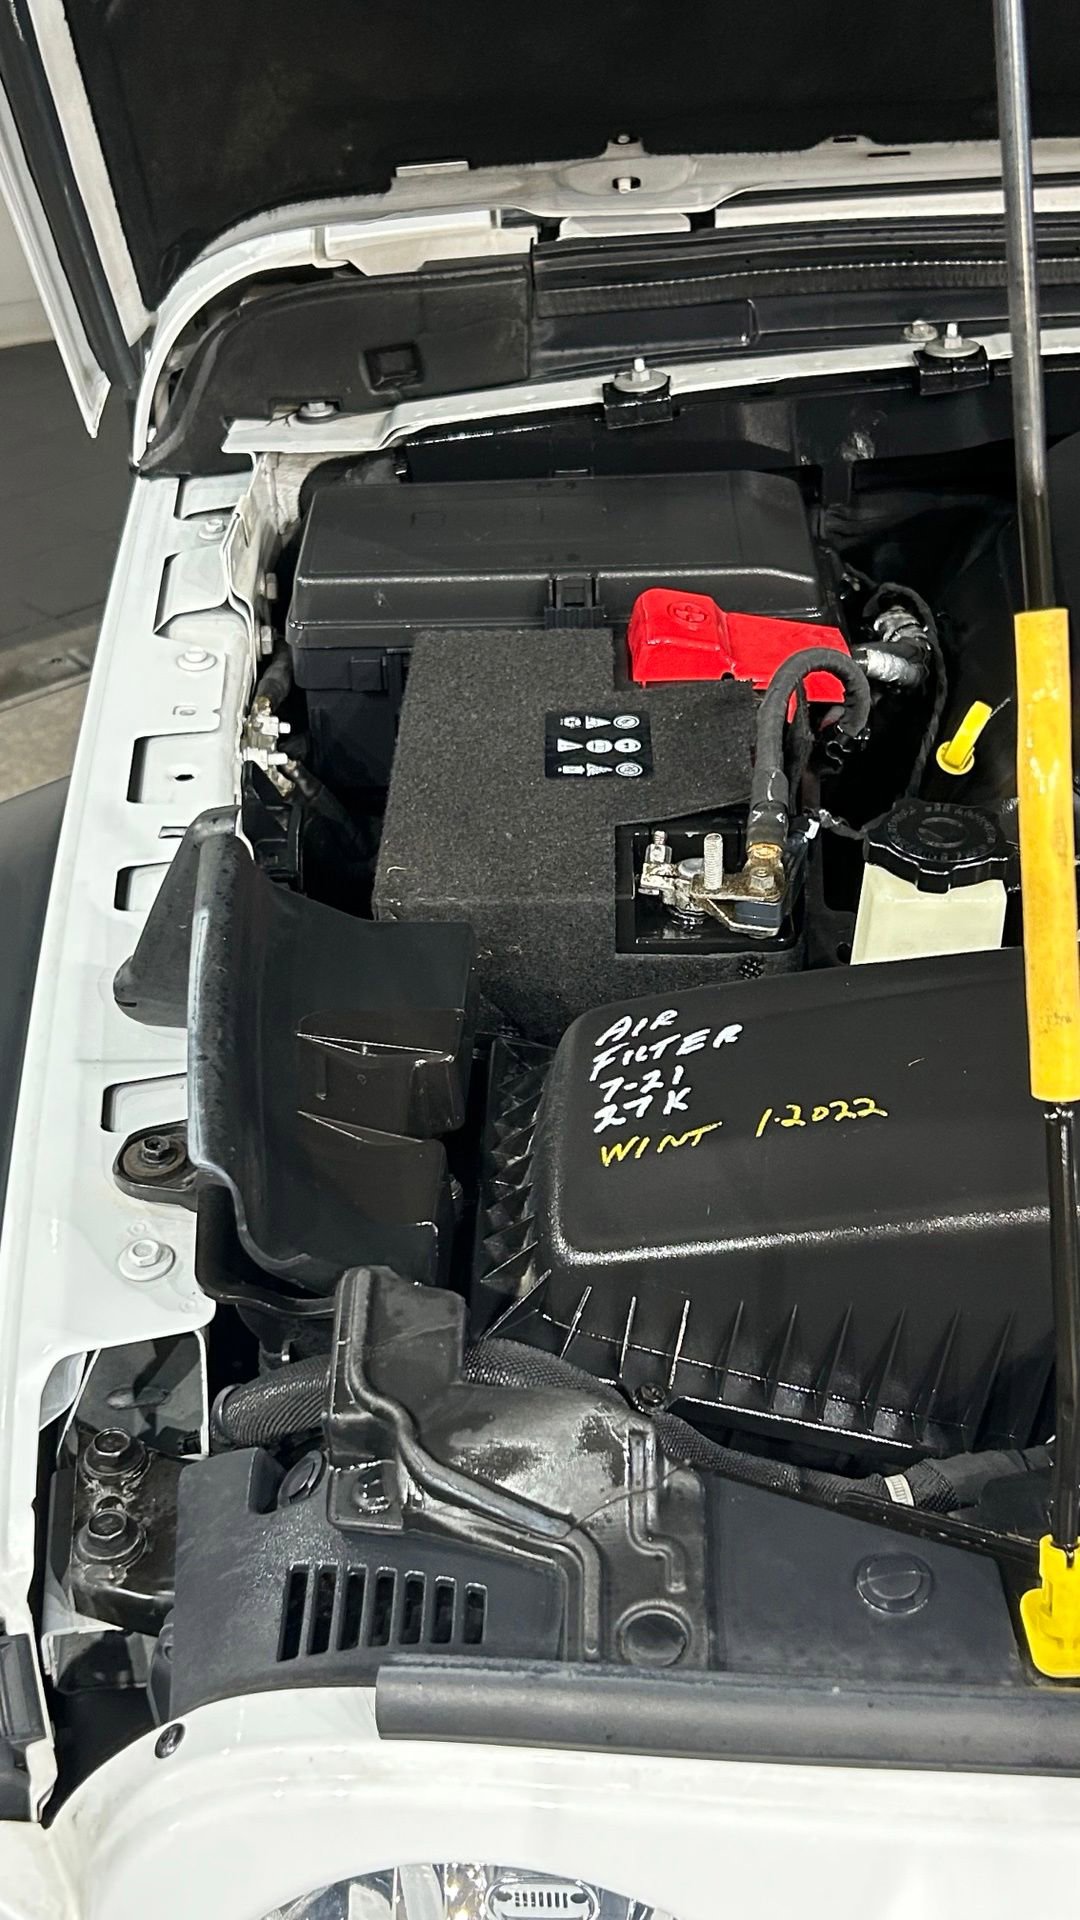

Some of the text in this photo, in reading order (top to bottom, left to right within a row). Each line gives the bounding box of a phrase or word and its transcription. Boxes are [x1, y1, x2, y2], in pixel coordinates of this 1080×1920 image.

[594, 1009, 678, 1047] AIR
[588, 1024, 743, 1082] FILTER
[598, 1065, 686, 1104] 7-21
[600, 1121, 723, 1168] WINT
